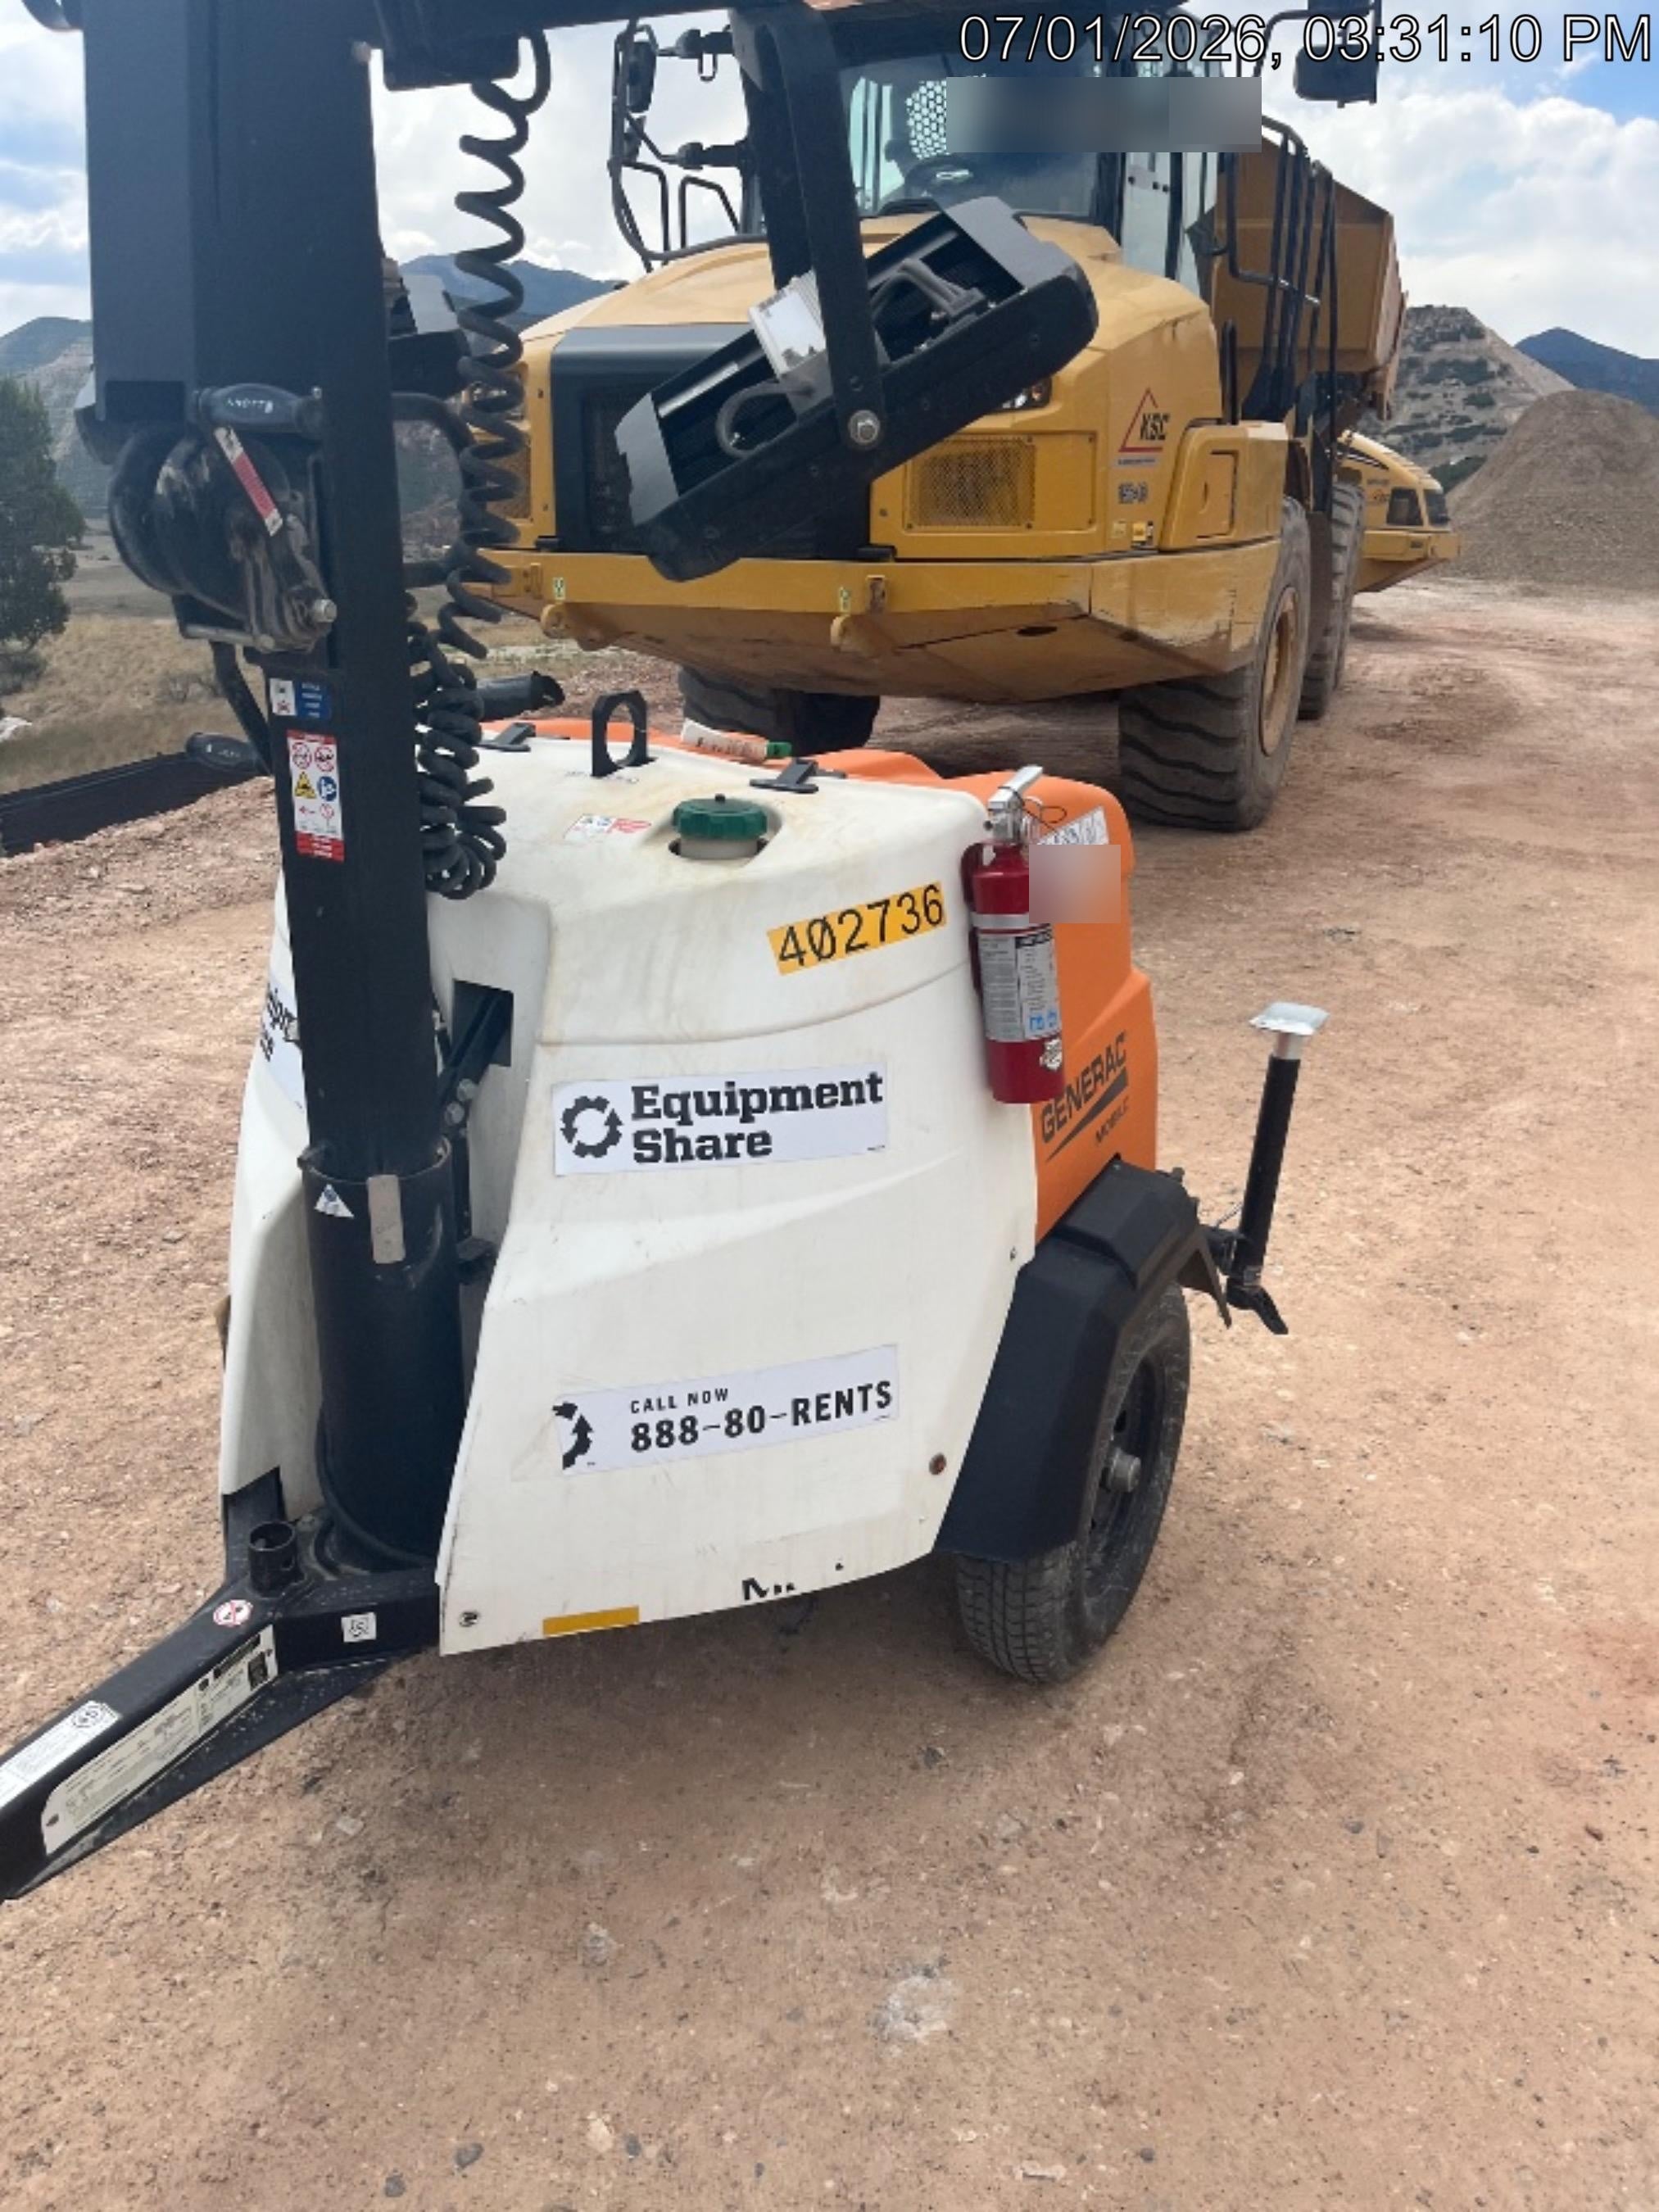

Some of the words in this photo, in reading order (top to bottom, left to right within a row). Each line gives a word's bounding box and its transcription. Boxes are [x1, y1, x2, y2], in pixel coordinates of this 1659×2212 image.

[1140, 412, 1171, 441] KSC
[778, 883, 942, 967] 402736
[631, 1072, 884, 1126] Equipment
[1041, 1030, 1127, 1144] GENERAC
[632, 1127, 773, 1164] Share
[630, 1394, 678, 1415] CALL
[687, 1388, 730, 1407] NOW
[630, 1380, 893, 1453] 888-80-RENTS
